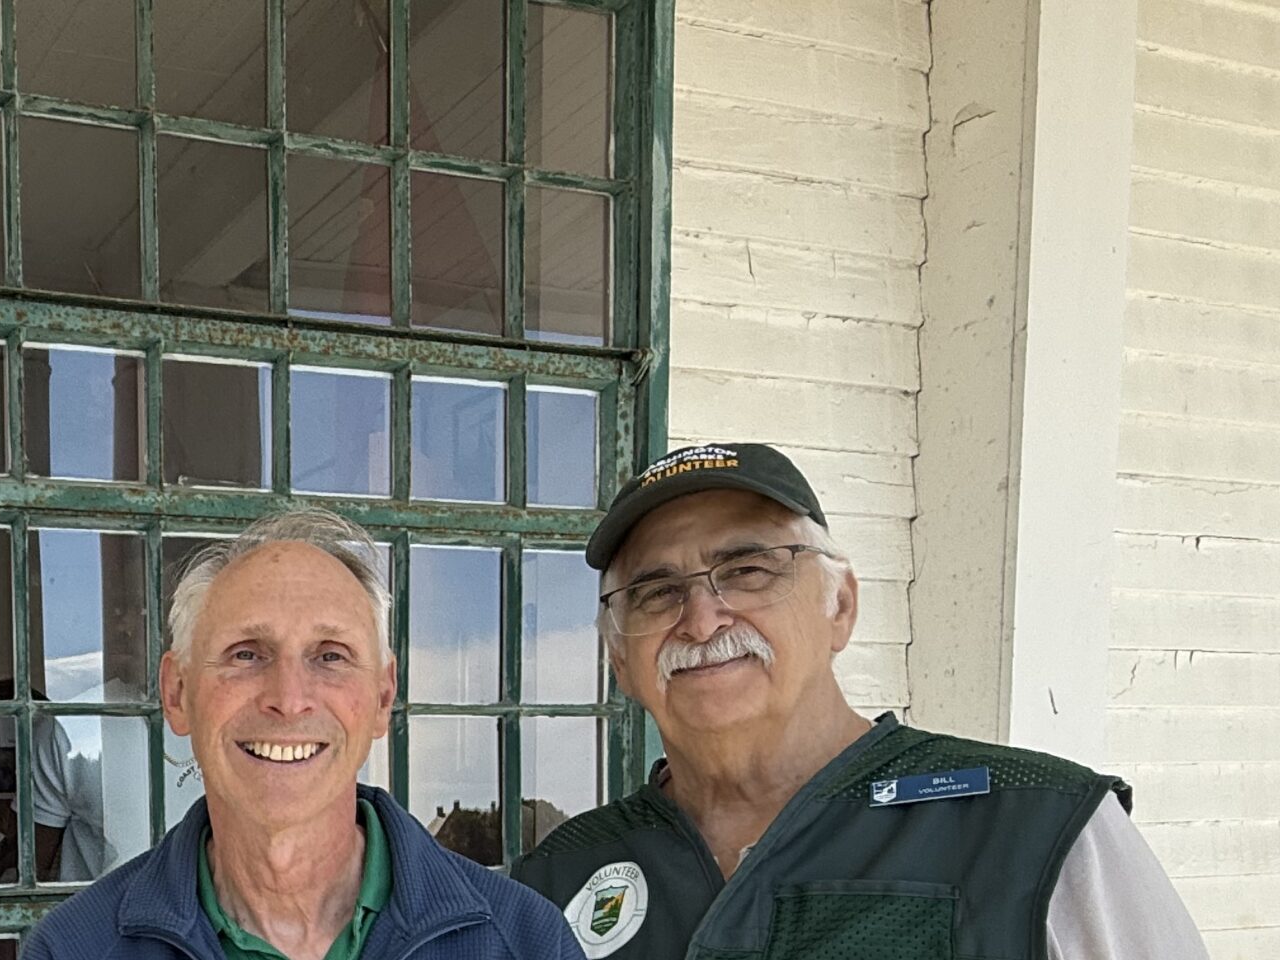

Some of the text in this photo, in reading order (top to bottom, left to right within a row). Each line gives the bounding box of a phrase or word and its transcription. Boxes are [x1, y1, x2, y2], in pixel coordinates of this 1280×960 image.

[932, 776, 956, 785] BILL
[918, 783, 969, 795] VOLUNTEER
[585, 866, 640, 892] VOLUNTEER
